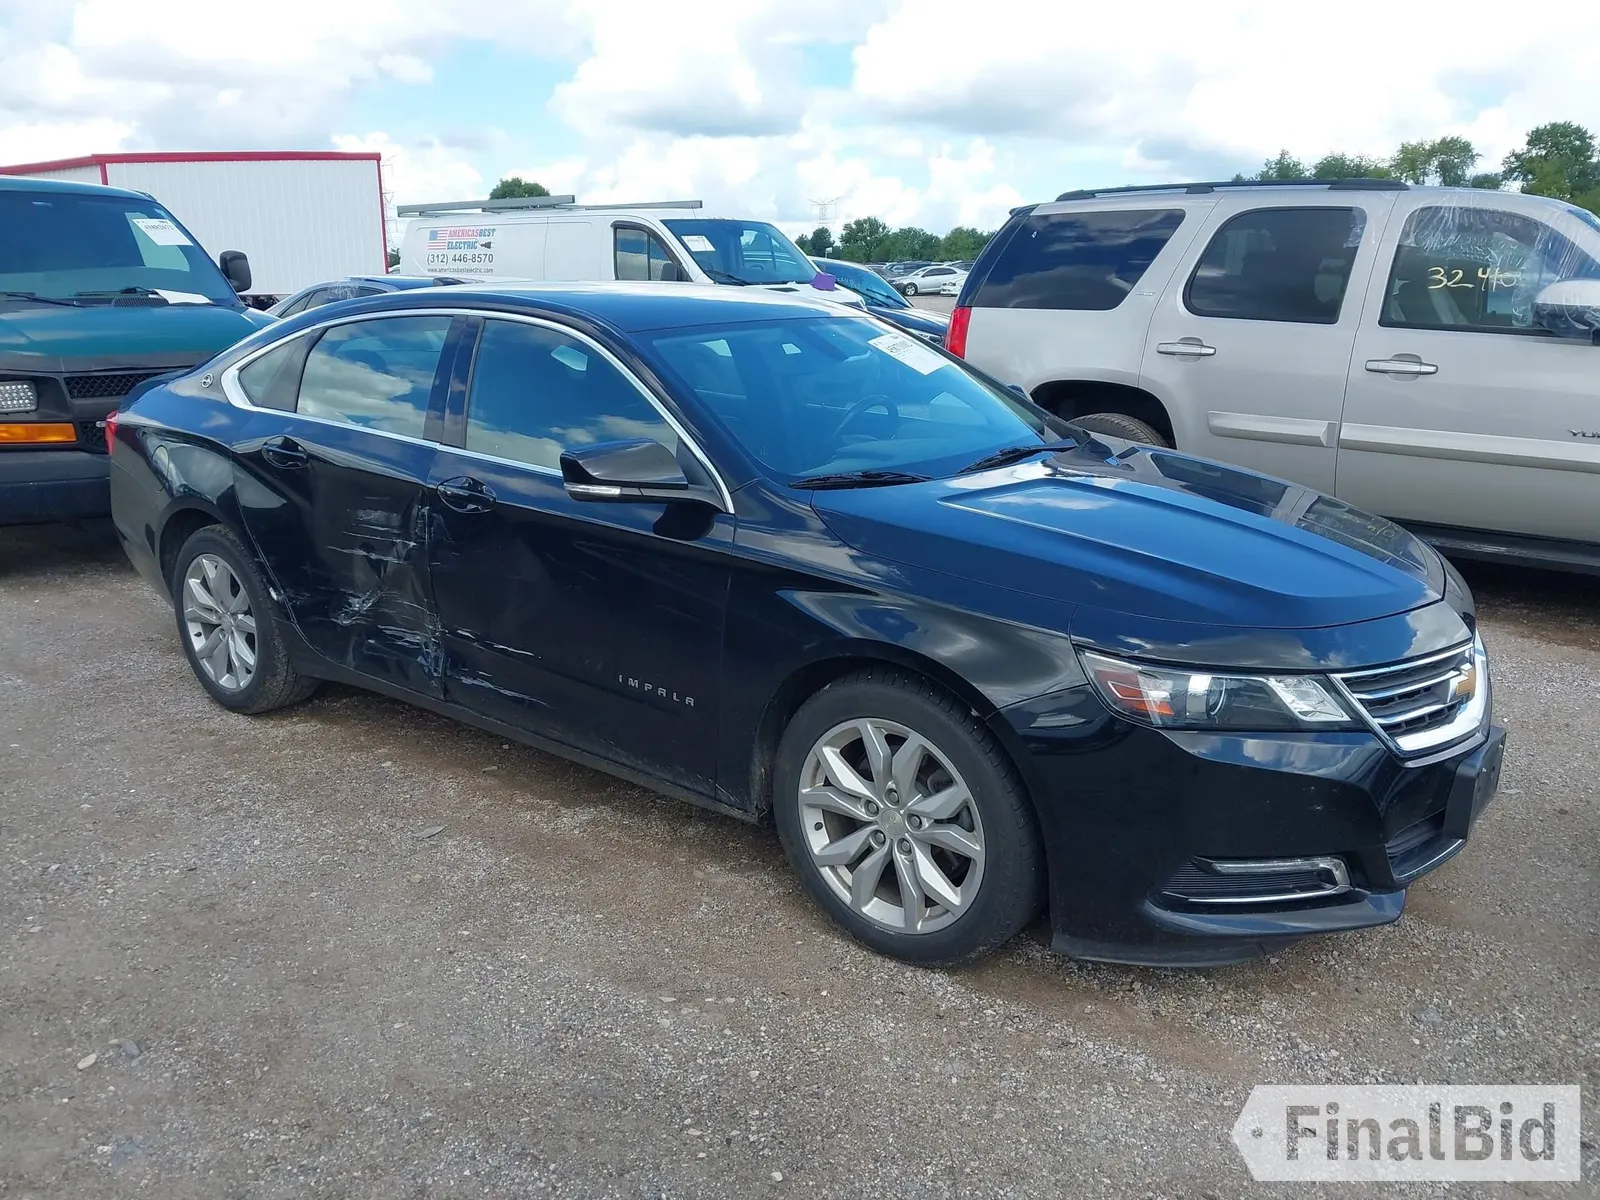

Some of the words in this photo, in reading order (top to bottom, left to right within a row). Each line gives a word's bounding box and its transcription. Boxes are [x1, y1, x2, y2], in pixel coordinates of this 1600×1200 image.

[447, 241, 478, 250] ELECTRIC
[427, 253, 449, 266] (312)
[451, 253, 494, 263] 446-8570
[618, 674, 695, 707] IMPALA
